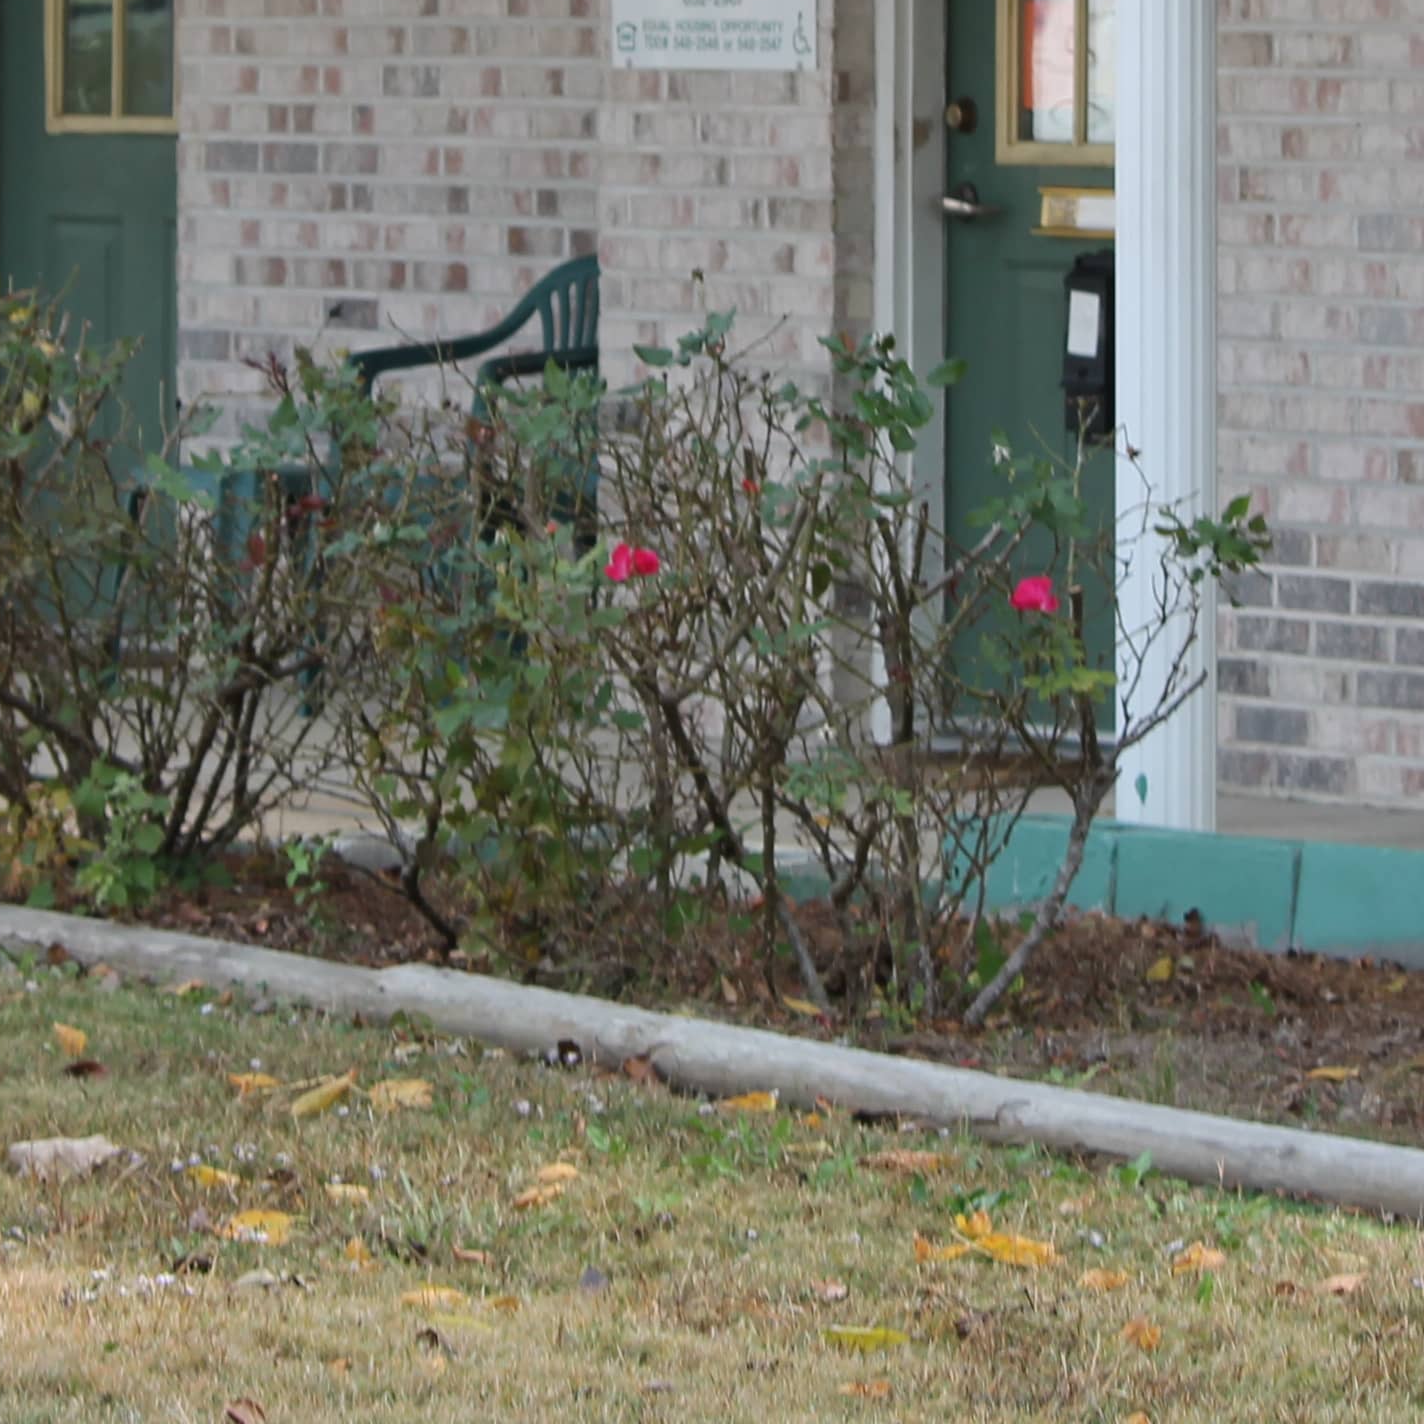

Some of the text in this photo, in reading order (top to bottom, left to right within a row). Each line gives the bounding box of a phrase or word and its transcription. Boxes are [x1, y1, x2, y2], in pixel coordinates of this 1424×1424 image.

[642, 19, 782, 33] EQUAL HOUSING OPPORTUNITY
